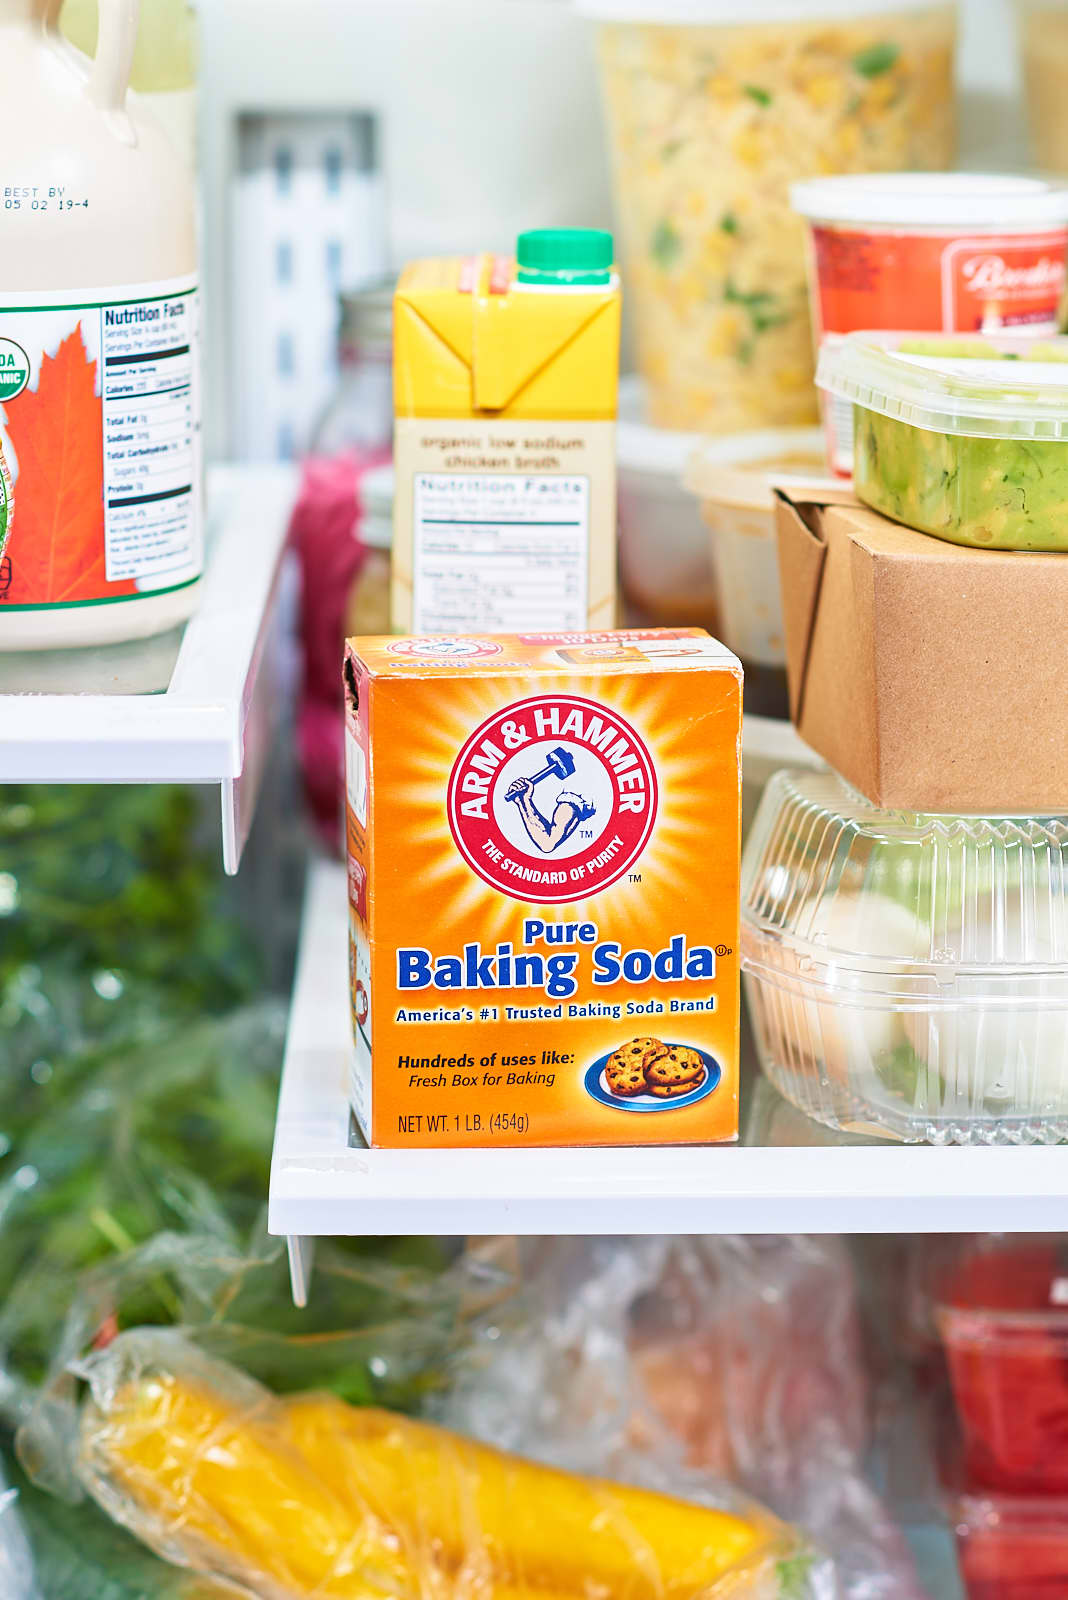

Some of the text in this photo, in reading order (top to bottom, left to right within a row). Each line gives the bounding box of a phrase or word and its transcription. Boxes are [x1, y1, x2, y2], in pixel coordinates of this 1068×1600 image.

[4, 187, 65, 198] BEST BY
[5, 199, 89, 210] 05 02 19-4
[105, 307, 160, 326] Nutrition
[0, 354, 15, 367] DA
[0, 372, 21, 384] ANIC
[421, 436, 585, 450] organic low sodium
[445, 456, 561, 468] chicken broth
[420, 479, 582, 493] Nutrition Facts
[460, 707, 646, 820] ARM & HAMMER
[579, 830, 593, 839] TM
[481, 834, 625, 885] THE STANDARD OF PURITY
[628, 874, 642, 883] TM
[524, 920, 597, 945] Pure
[397, 936, 714, 998] Baking Soda
[396, 997, 716, 1022] America's #1 Trusted Baking Soda Brand
[398, 1051, 576, 1069] Hundreds of uses like:
[408, 1071, 556, 1088] Fresh Box for Baking
[398, 1113, 530, 1135] NET WT. 1 LB. (454g)
